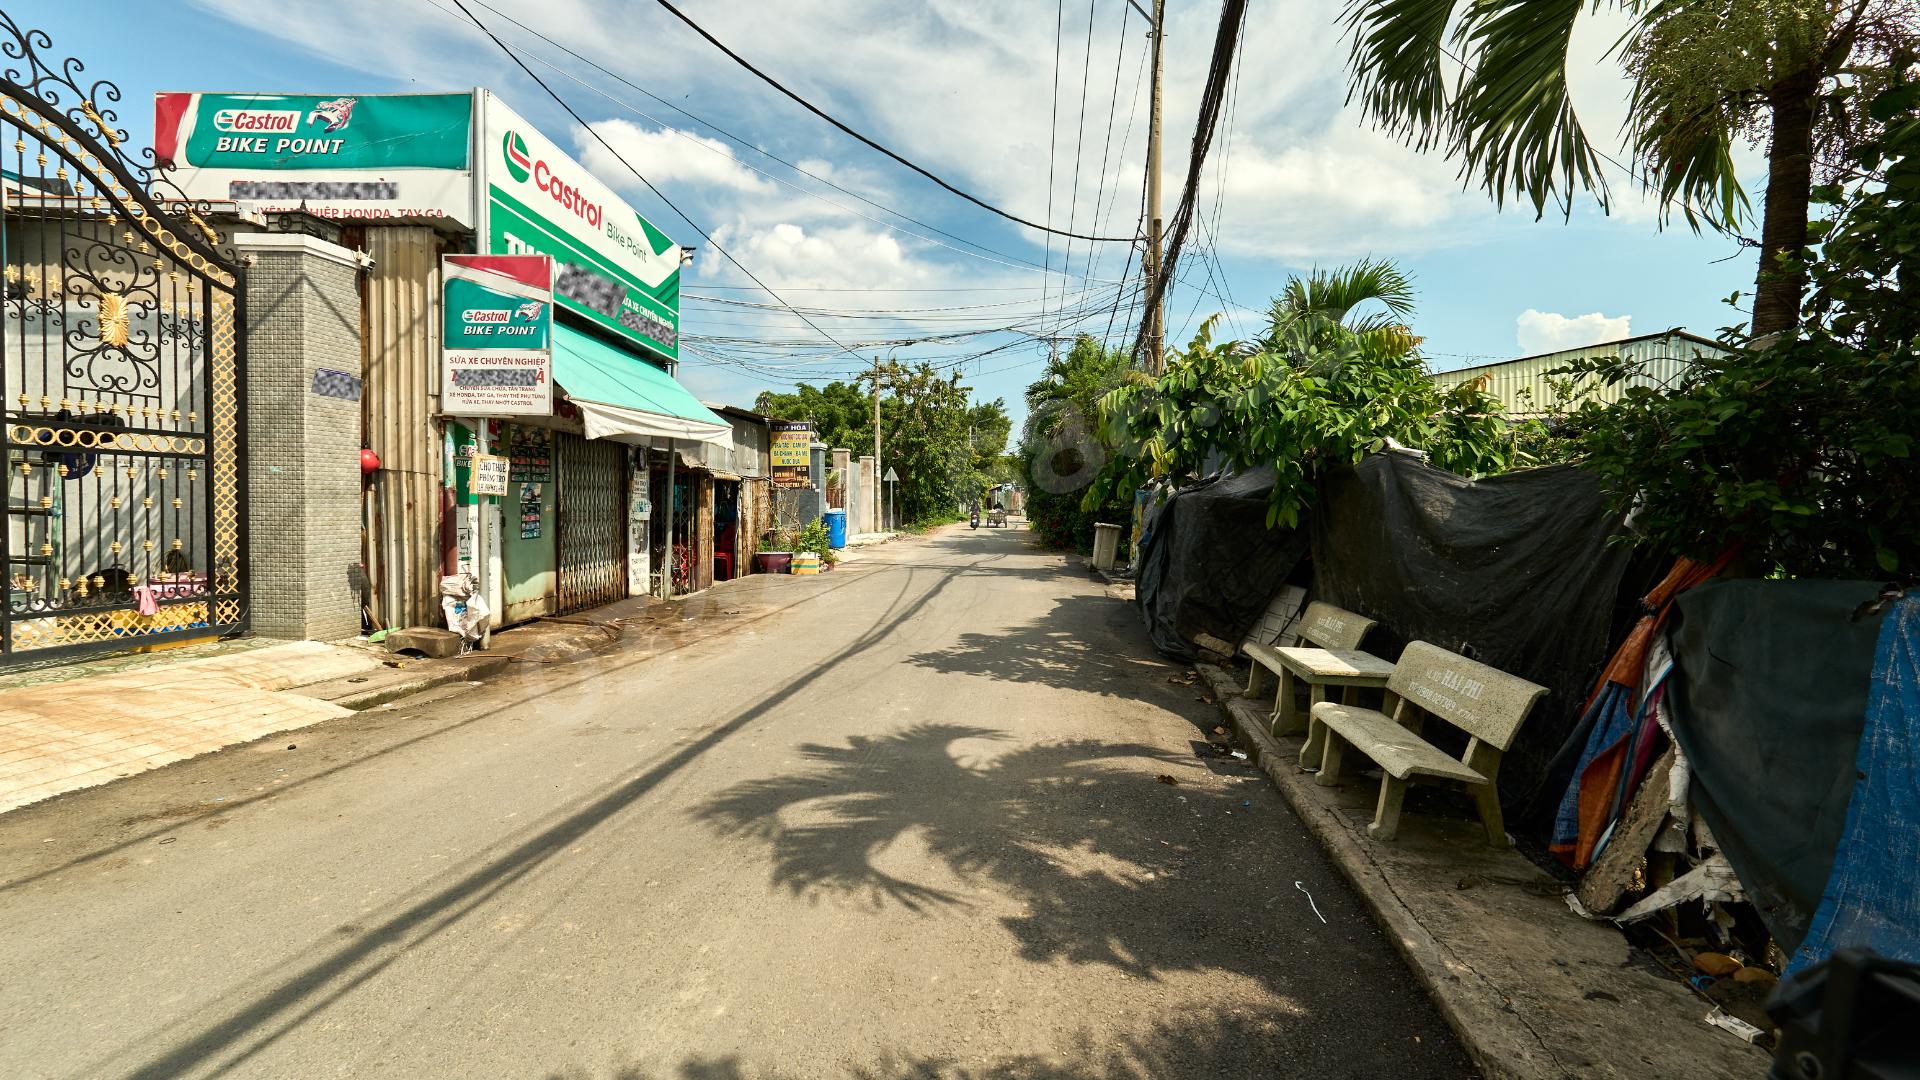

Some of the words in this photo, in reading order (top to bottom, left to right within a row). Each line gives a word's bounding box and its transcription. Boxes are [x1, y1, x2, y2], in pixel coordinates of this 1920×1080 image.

[233, 112, 293, 131] Castrol
[216, 137, 268, 153] BIKE
[275, 138, 345, 155] POINT
[534, 159, 602, 231] Castrol
[607, 222, 625, 247] Bike
[626, 236, 647, 263] Point
[474, 311, 508, 322] Castrol
[464, 326, 493, 335] BIKE
[498, 326, 536, 335] POINT
[449, 355, 466, 365] SỬA
[468, 357, 479, 365] XE
[480, 356, 513, 365] CHUYÊN
